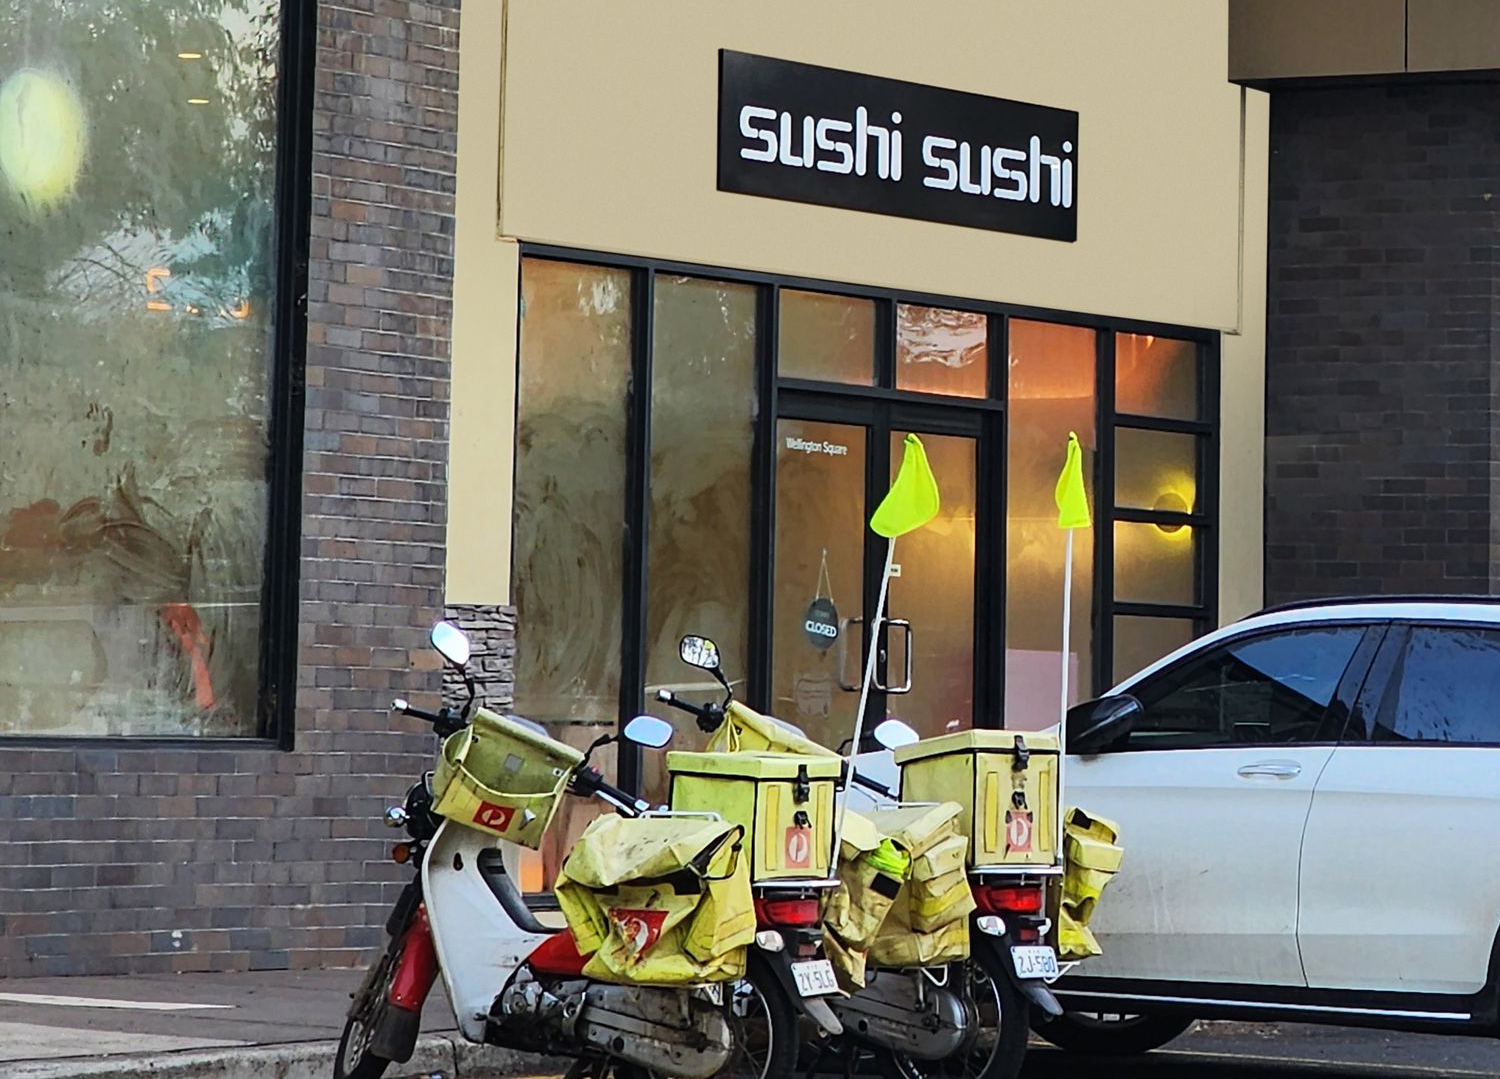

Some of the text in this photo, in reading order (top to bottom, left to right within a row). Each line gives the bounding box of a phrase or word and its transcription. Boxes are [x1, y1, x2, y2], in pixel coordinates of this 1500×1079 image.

[740, 105, 1073, 209] sushi sushi
[786, 437, 848, 456] Wellington Square
[805, 621, 837, 638] CLOSED
